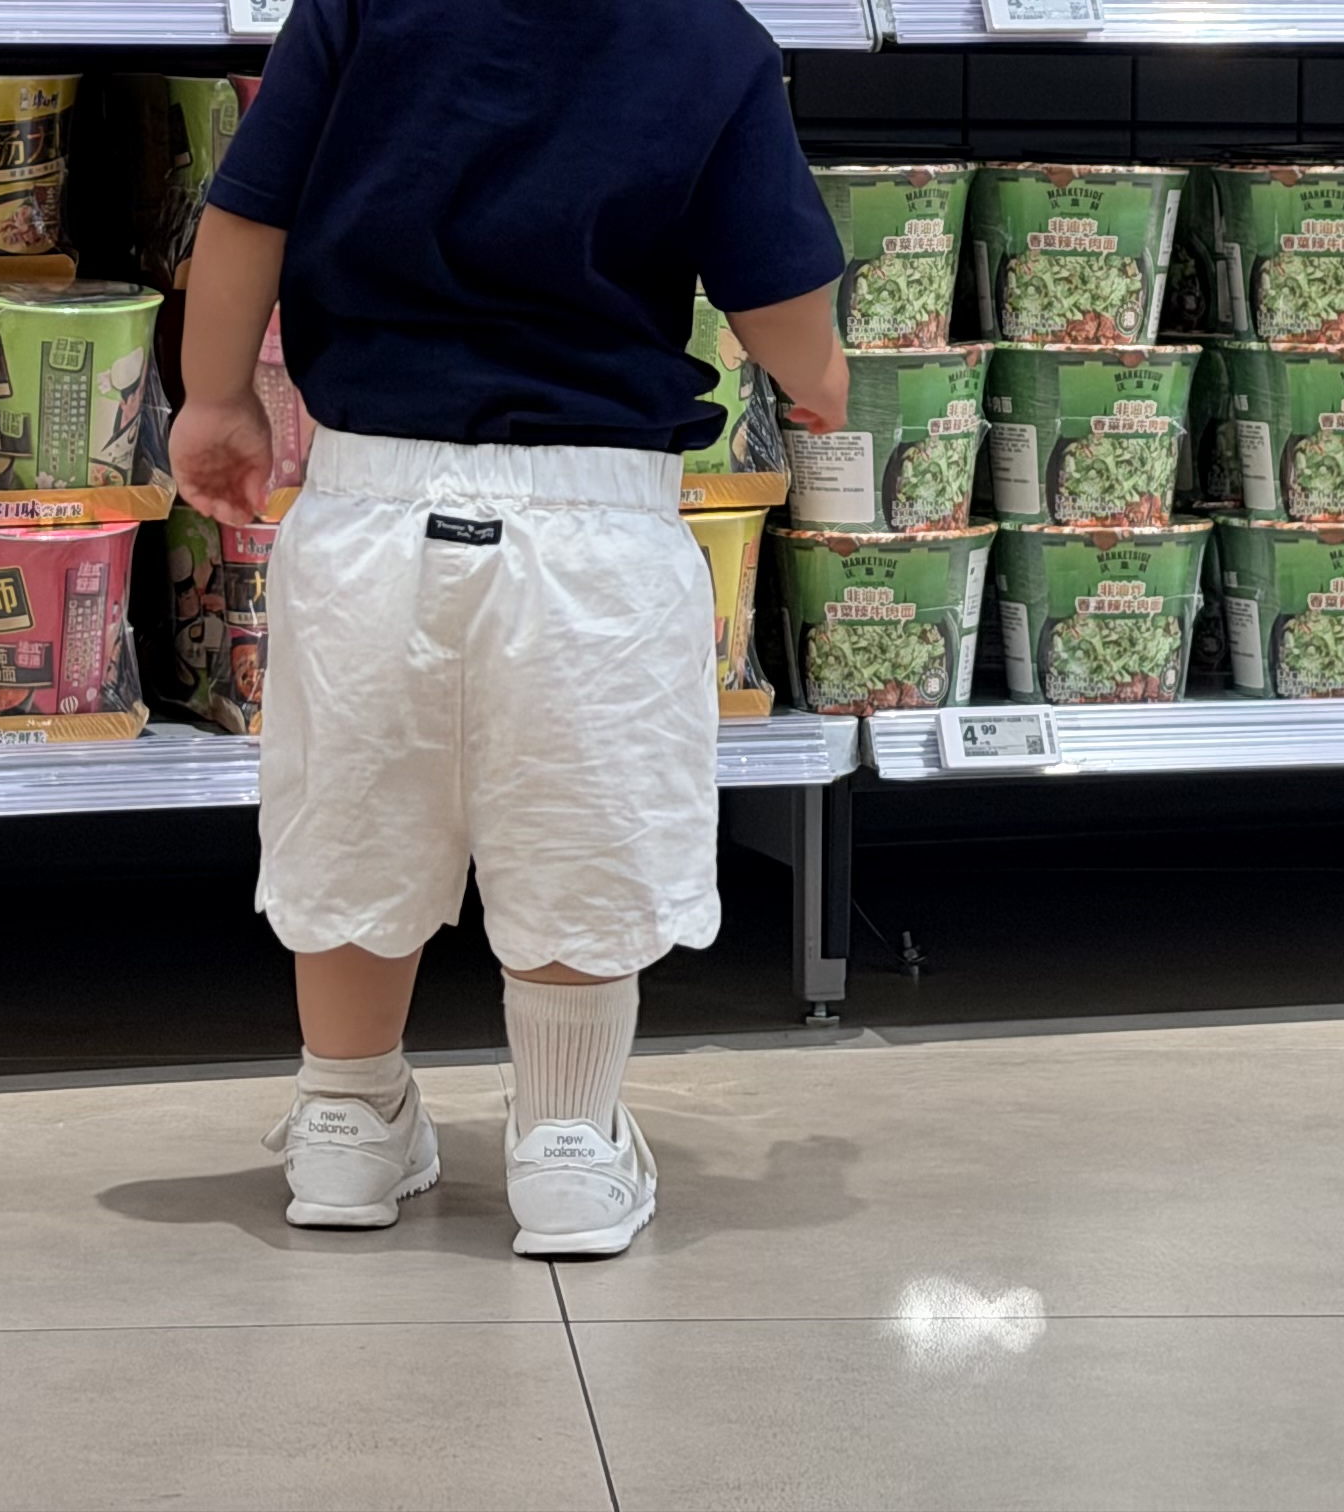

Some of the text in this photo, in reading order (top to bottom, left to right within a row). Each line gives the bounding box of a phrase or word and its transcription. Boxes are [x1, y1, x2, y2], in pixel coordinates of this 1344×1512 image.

[1047, 189, 1104, 202] MARKETSIDE
[1048, 217, 1098, 235] 非油炸
[1027, 234, 1118, 254] 香菜辣牛肉面
[962, 724, 997, 746] 4 99
[308, 1120, 360, 1137] balance
[543, 1145, 596, 1159] balance
